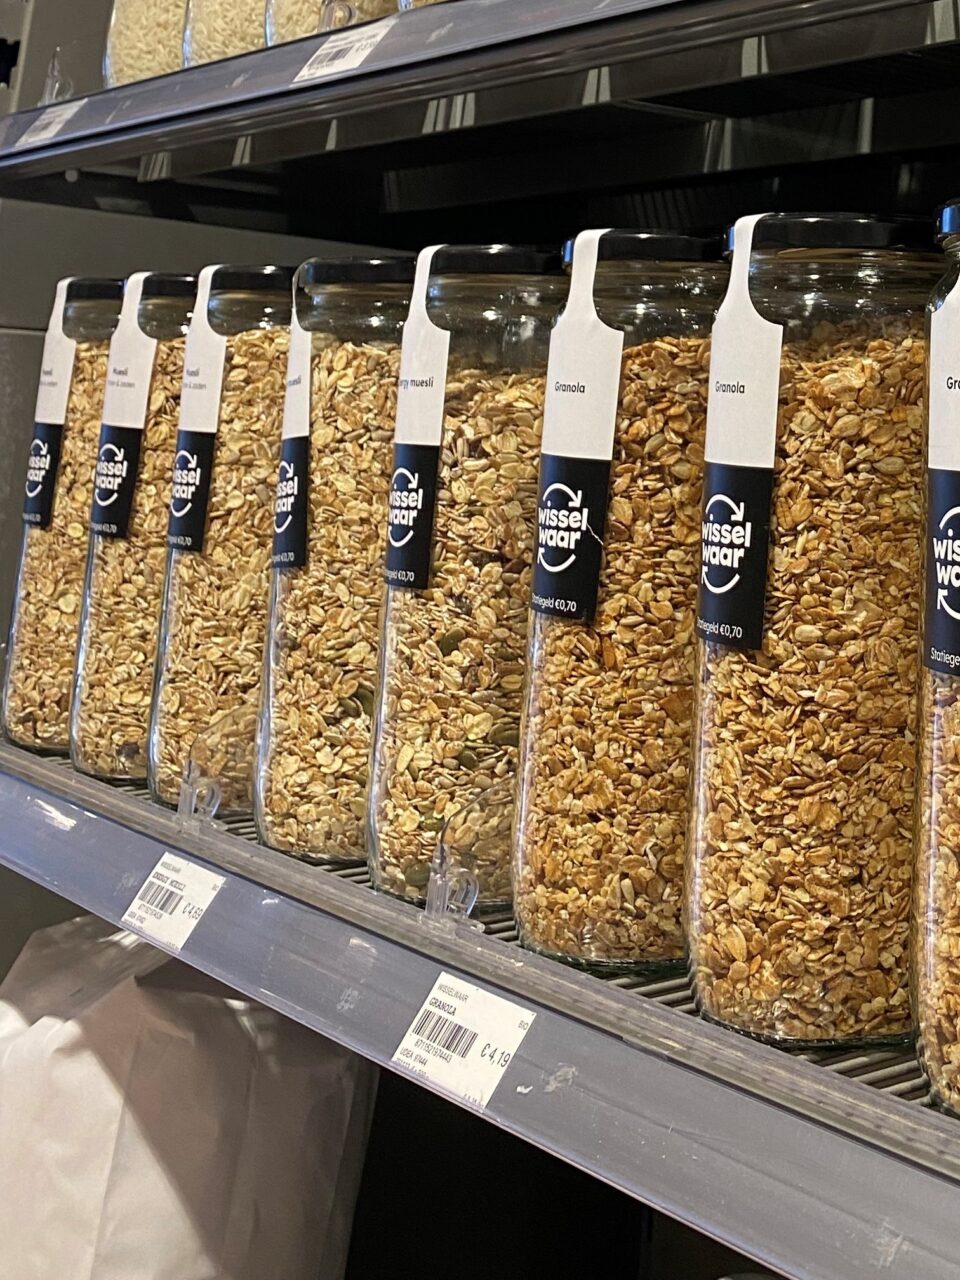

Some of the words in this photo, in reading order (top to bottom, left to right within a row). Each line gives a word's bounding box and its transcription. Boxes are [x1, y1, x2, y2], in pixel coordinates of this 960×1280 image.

[410, 376, 435, 388] muesli
[554, 381, 586, 394] Granola
[715, 380, 746, 395] Granola
[538, 499, 589, 531] wissel
[538, 527, 582, 550] waar
[701, 513, 752, 548] wissel
[702, 542, 745, 569] waar
[554, 597, 577, 613] €0,70
[719, 620, 743, 639] €0,70
[428, 996, 457, 1017] GRANOLA
[489, 1048, 512, 1069] 4,19
